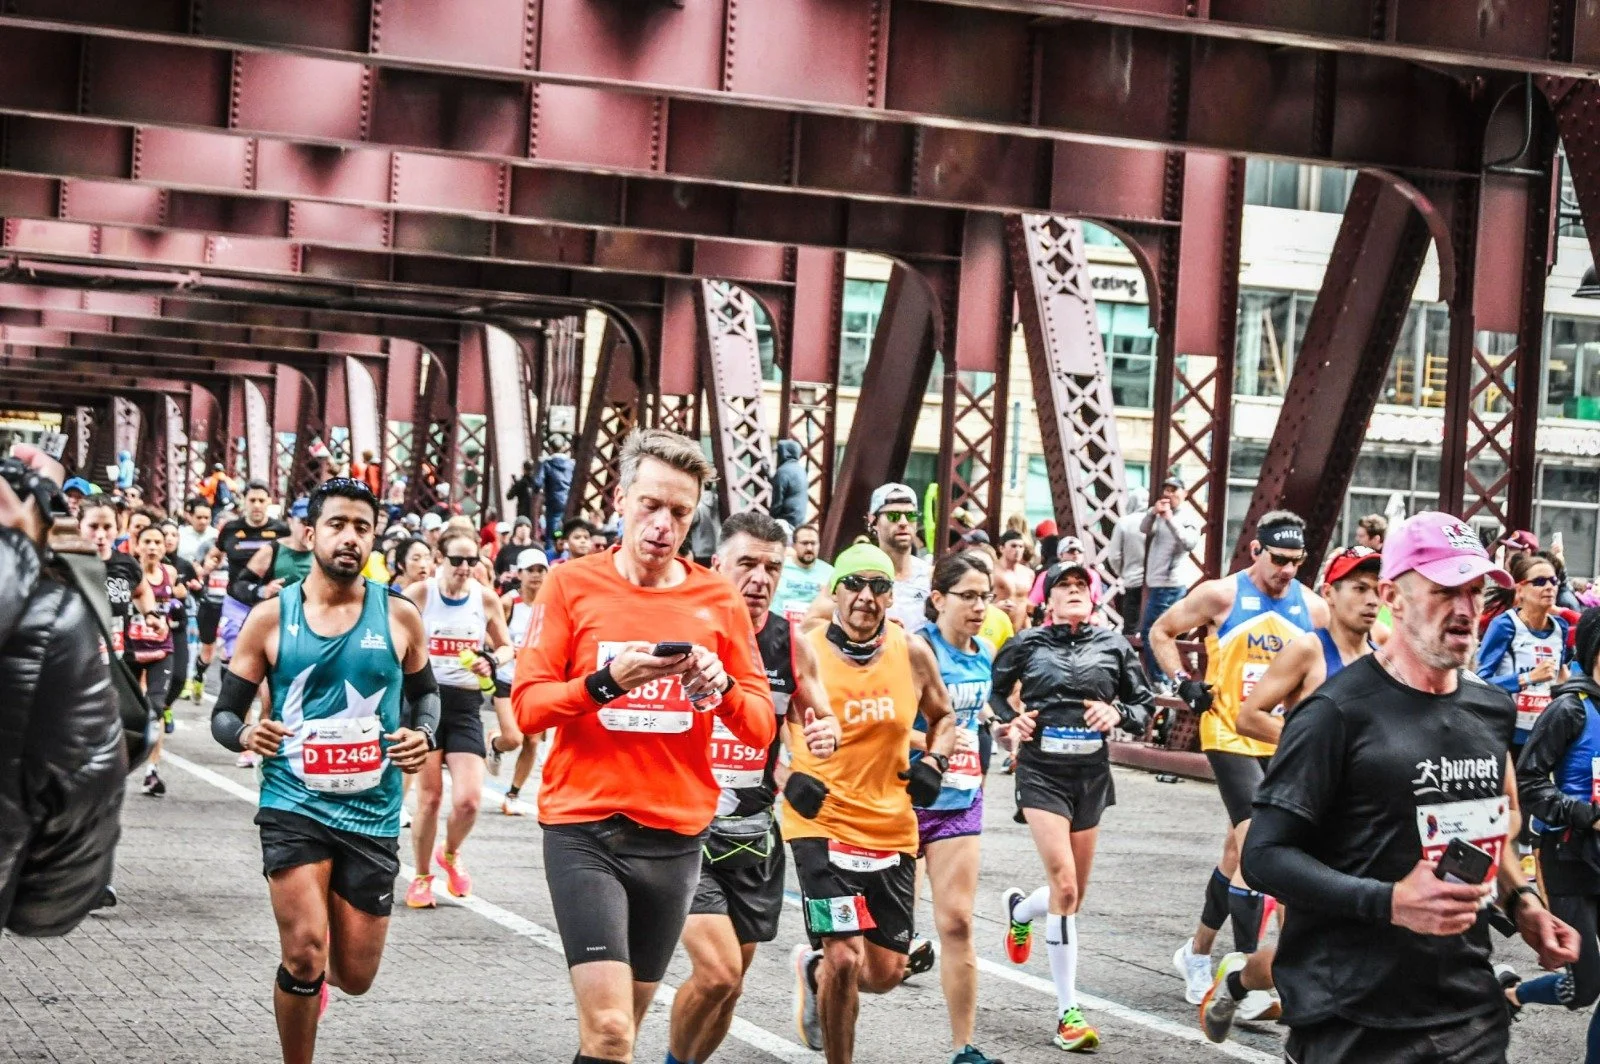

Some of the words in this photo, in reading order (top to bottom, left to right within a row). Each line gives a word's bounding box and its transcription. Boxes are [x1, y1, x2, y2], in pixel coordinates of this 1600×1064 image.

[431, 639, 439, 650] E
[304, 748, 319, 764] D
[324, 745, 379, 765] 12462
[1440, 755, 1499, 781] bunert
